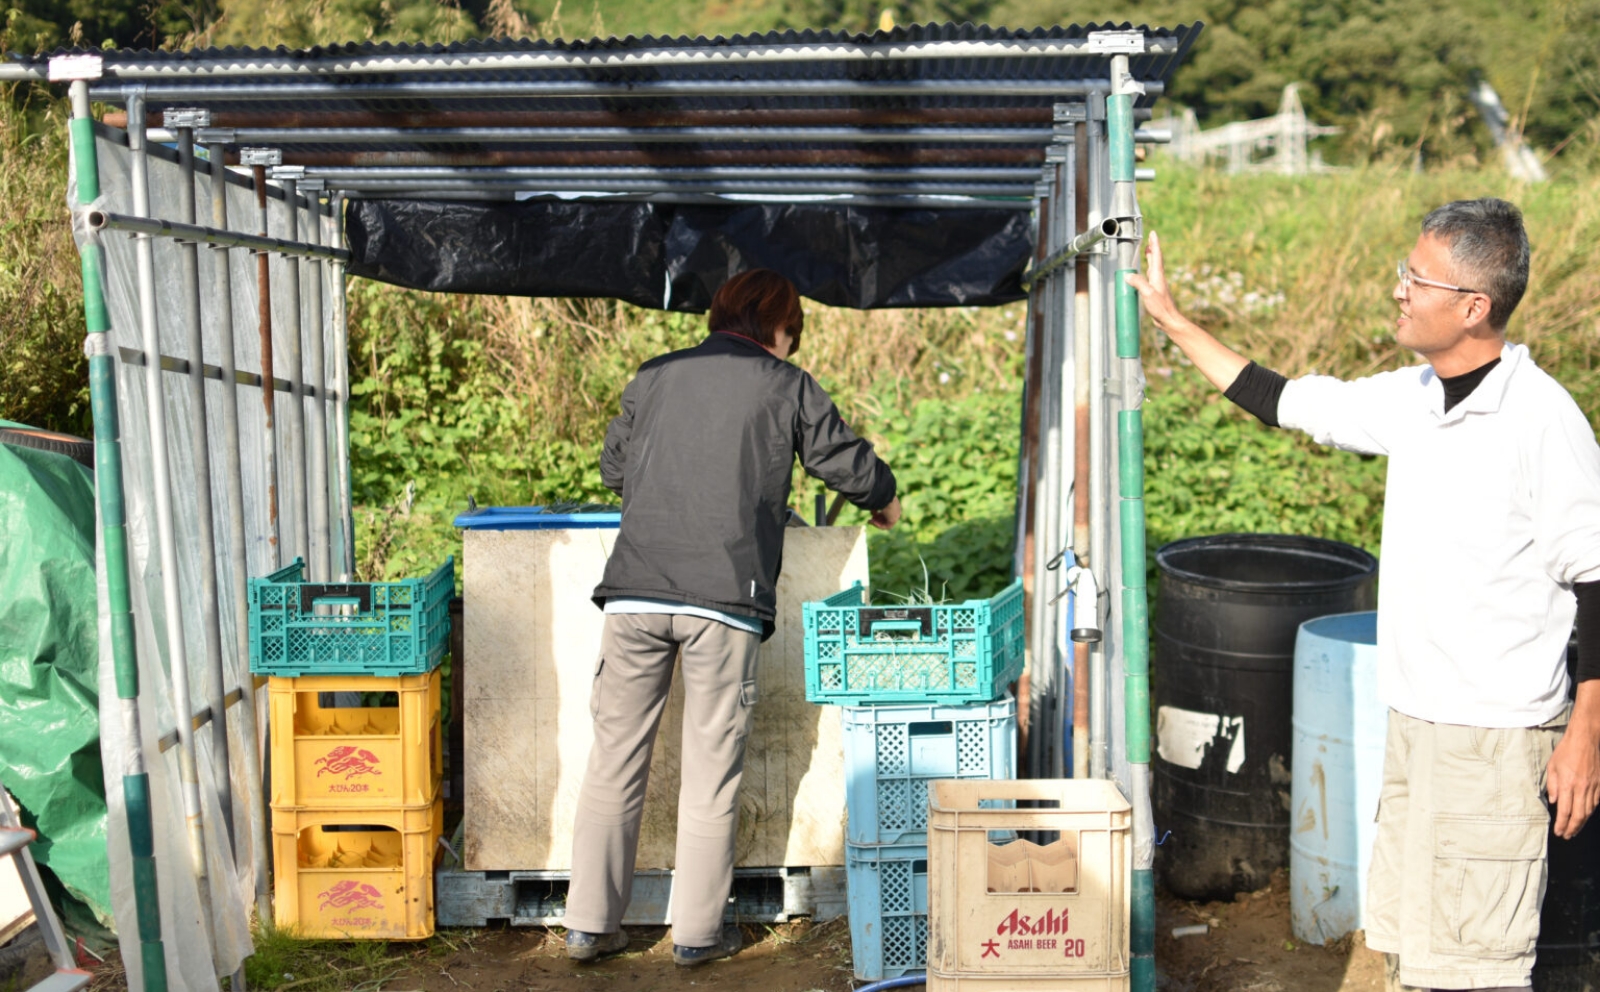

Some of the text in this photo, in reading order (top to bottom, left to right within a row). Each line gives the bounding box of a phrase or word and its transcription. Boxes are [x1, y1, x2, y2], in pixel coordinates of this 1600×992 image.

[997, 908, 1069, 936] Asahi
[981, 939, 1084, 958] 大 ASAHI BEER 20
